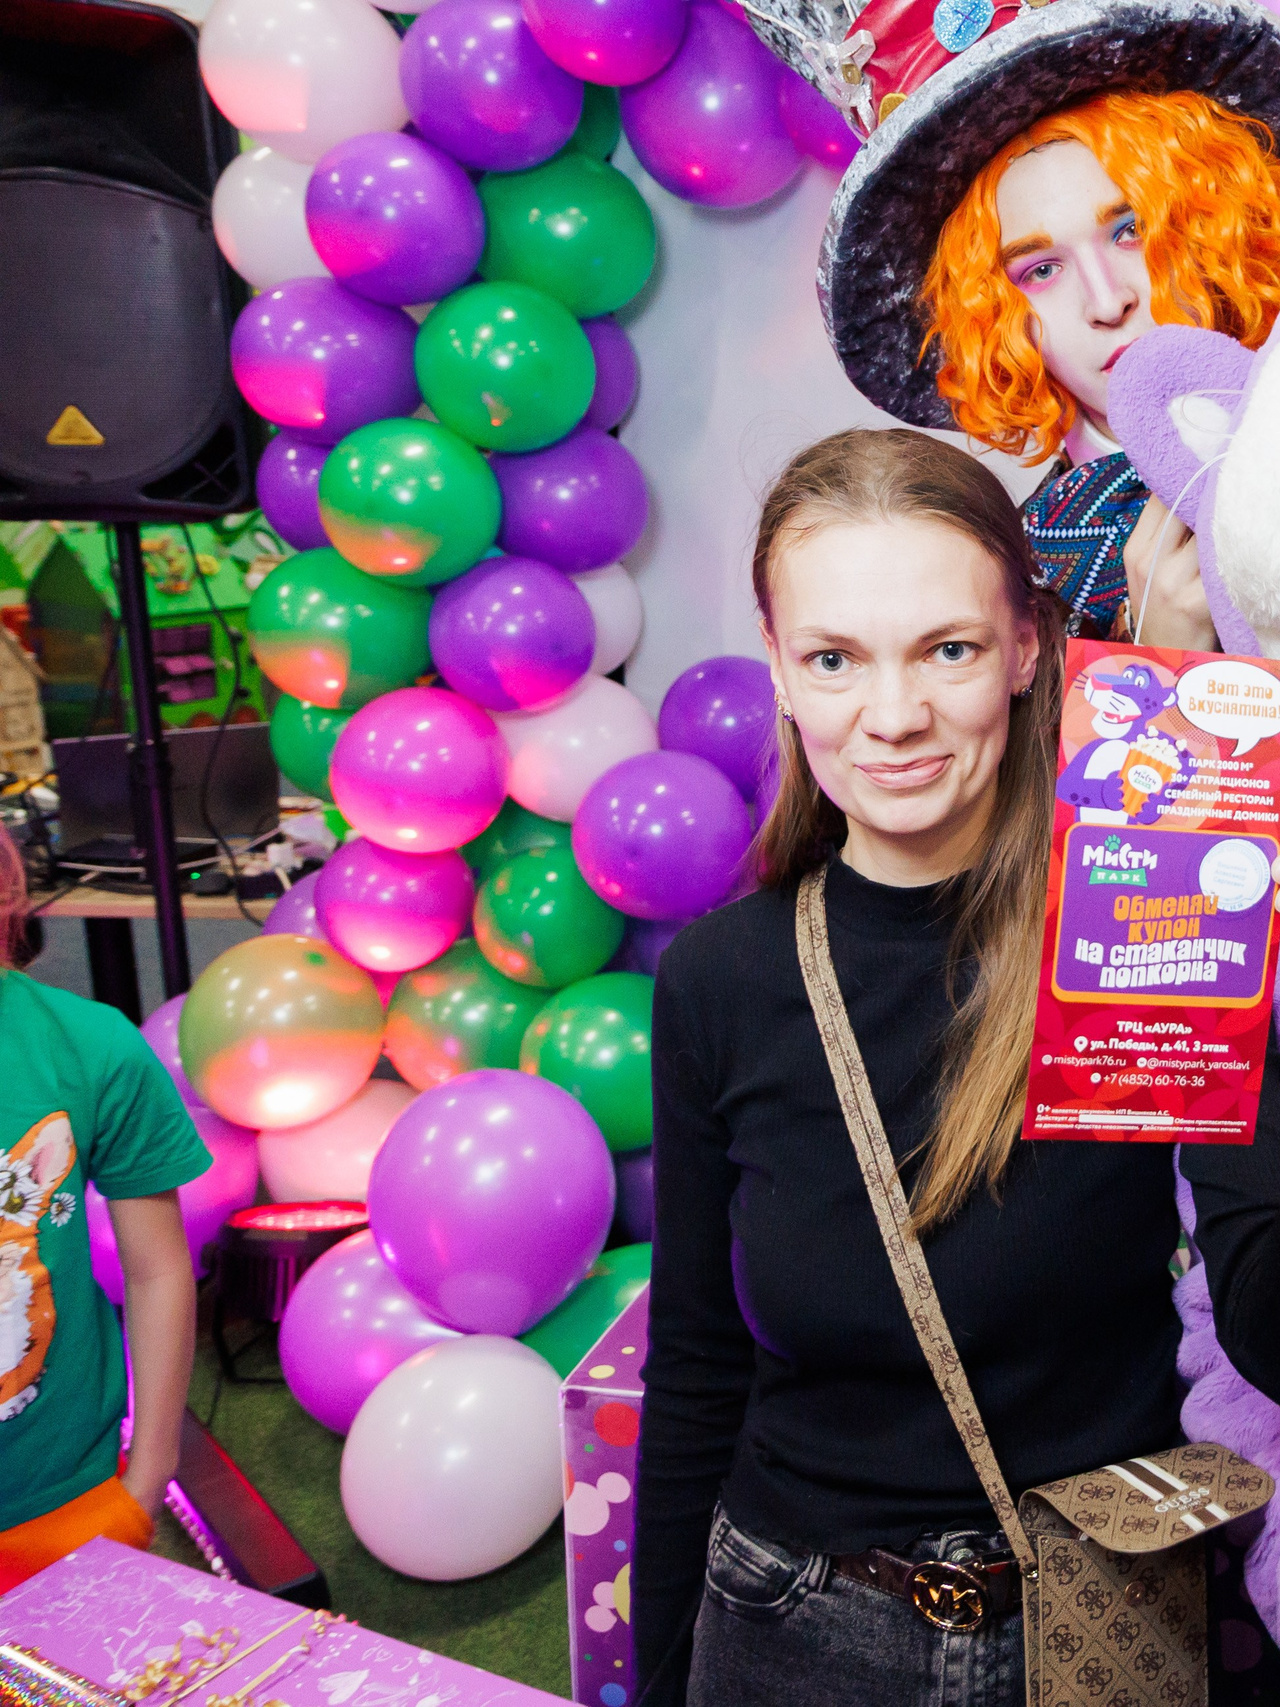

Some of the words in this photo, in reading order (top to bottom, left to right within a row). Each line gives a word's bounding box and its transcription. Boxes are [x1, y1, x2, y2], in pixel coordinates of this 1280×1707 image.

[1207, 679, 1239, 697] Вот
[1244, 684, 1273, 700] это
[1188, 758, 1216, 770] ПАРК
[1217, 760, 1240, 771] 2000
[1189, 774, 1270, 789] АТТРАКЦИОНОВ
[1164, 788, 1222, 801] СЕМЕЙНЫЙ
[1223, 794, 1274, 806] РЕСТОРАН
[1156, 804, 1233, 819] ПРАЗДНИЧНЫЕ
[1233, 810, 1280, 823] ДОМИКИ
[1096, 871, 1141, 883] ПАРК
[1113, 891, 1219, 921] Обменяй
[1127, 917, 1201, 944] купон
[1074, 938, 1104, 965] на
[1109, 938, 1247, 967] стаканчик
[1099, 960, 1219, 988] попкорна
[1117, 1021, 1143, 1035] ТРЦ
[1145, 1022, 1193, 1035] «АУРА»
[1090, 1040, 1107, 1051] ул.
[1109, 1038, 1158, 1052] Победы,
[1193, 1040, 1201, 1052] 3
[1202, 1043, 1229, 1053] этаж
[1053, 1055, 1127, 1068] mistypark76.ru
[1147, 1058, 1250, 1071] @mistypark_yaroslavl
[1103, 1073, 1117, 1084] +7
[1118, 1074, 1153, 1087] (4852)
[1154, 1075, 1205, 1087] 60-76-36
[1154, 1487, 1210, 1513] GUESS
